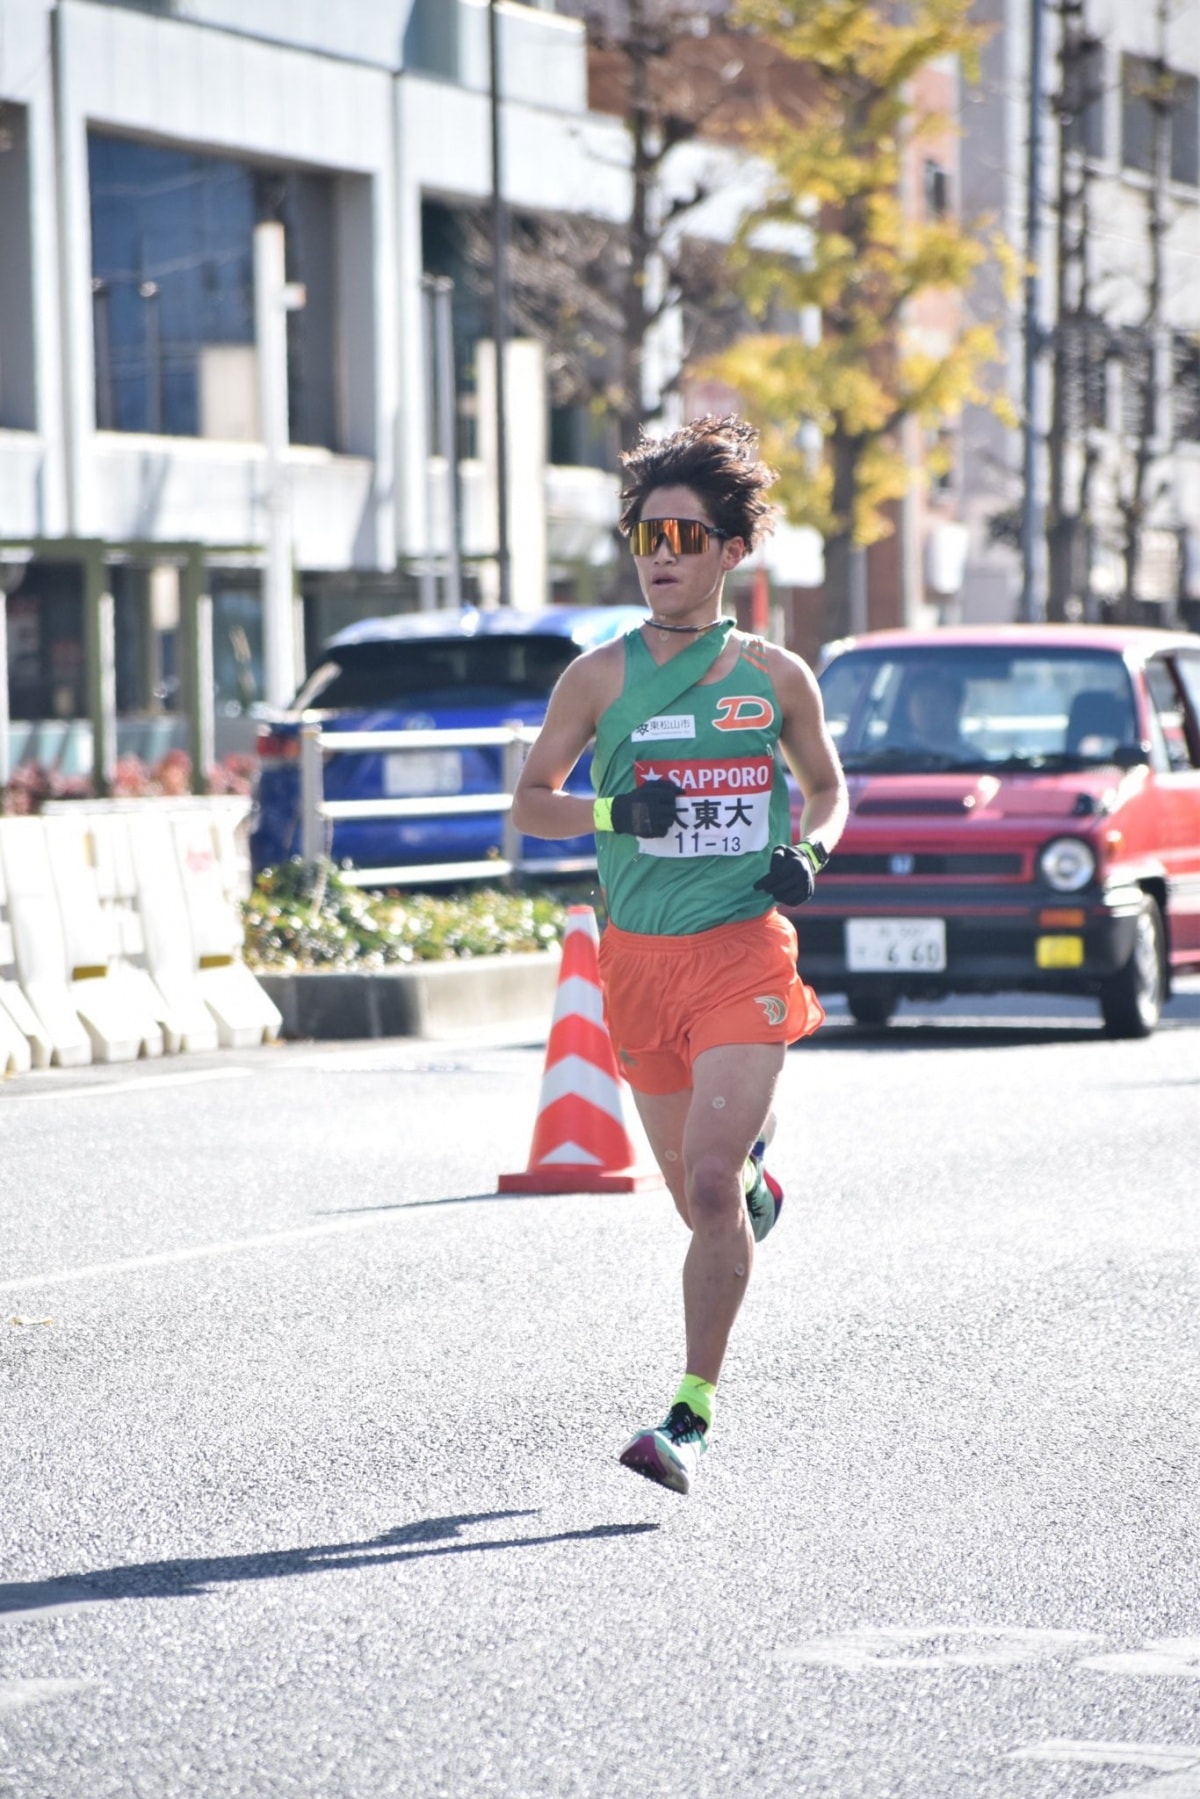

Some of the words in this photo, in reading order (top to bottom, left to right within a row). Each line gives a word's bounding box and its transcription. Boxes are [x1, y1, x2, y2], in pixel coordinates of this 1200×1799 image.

[711, 695, 775, 732] D
[668, 765, 769, 790] SAPPORO
[674, 831, 741, 854] 11-13
